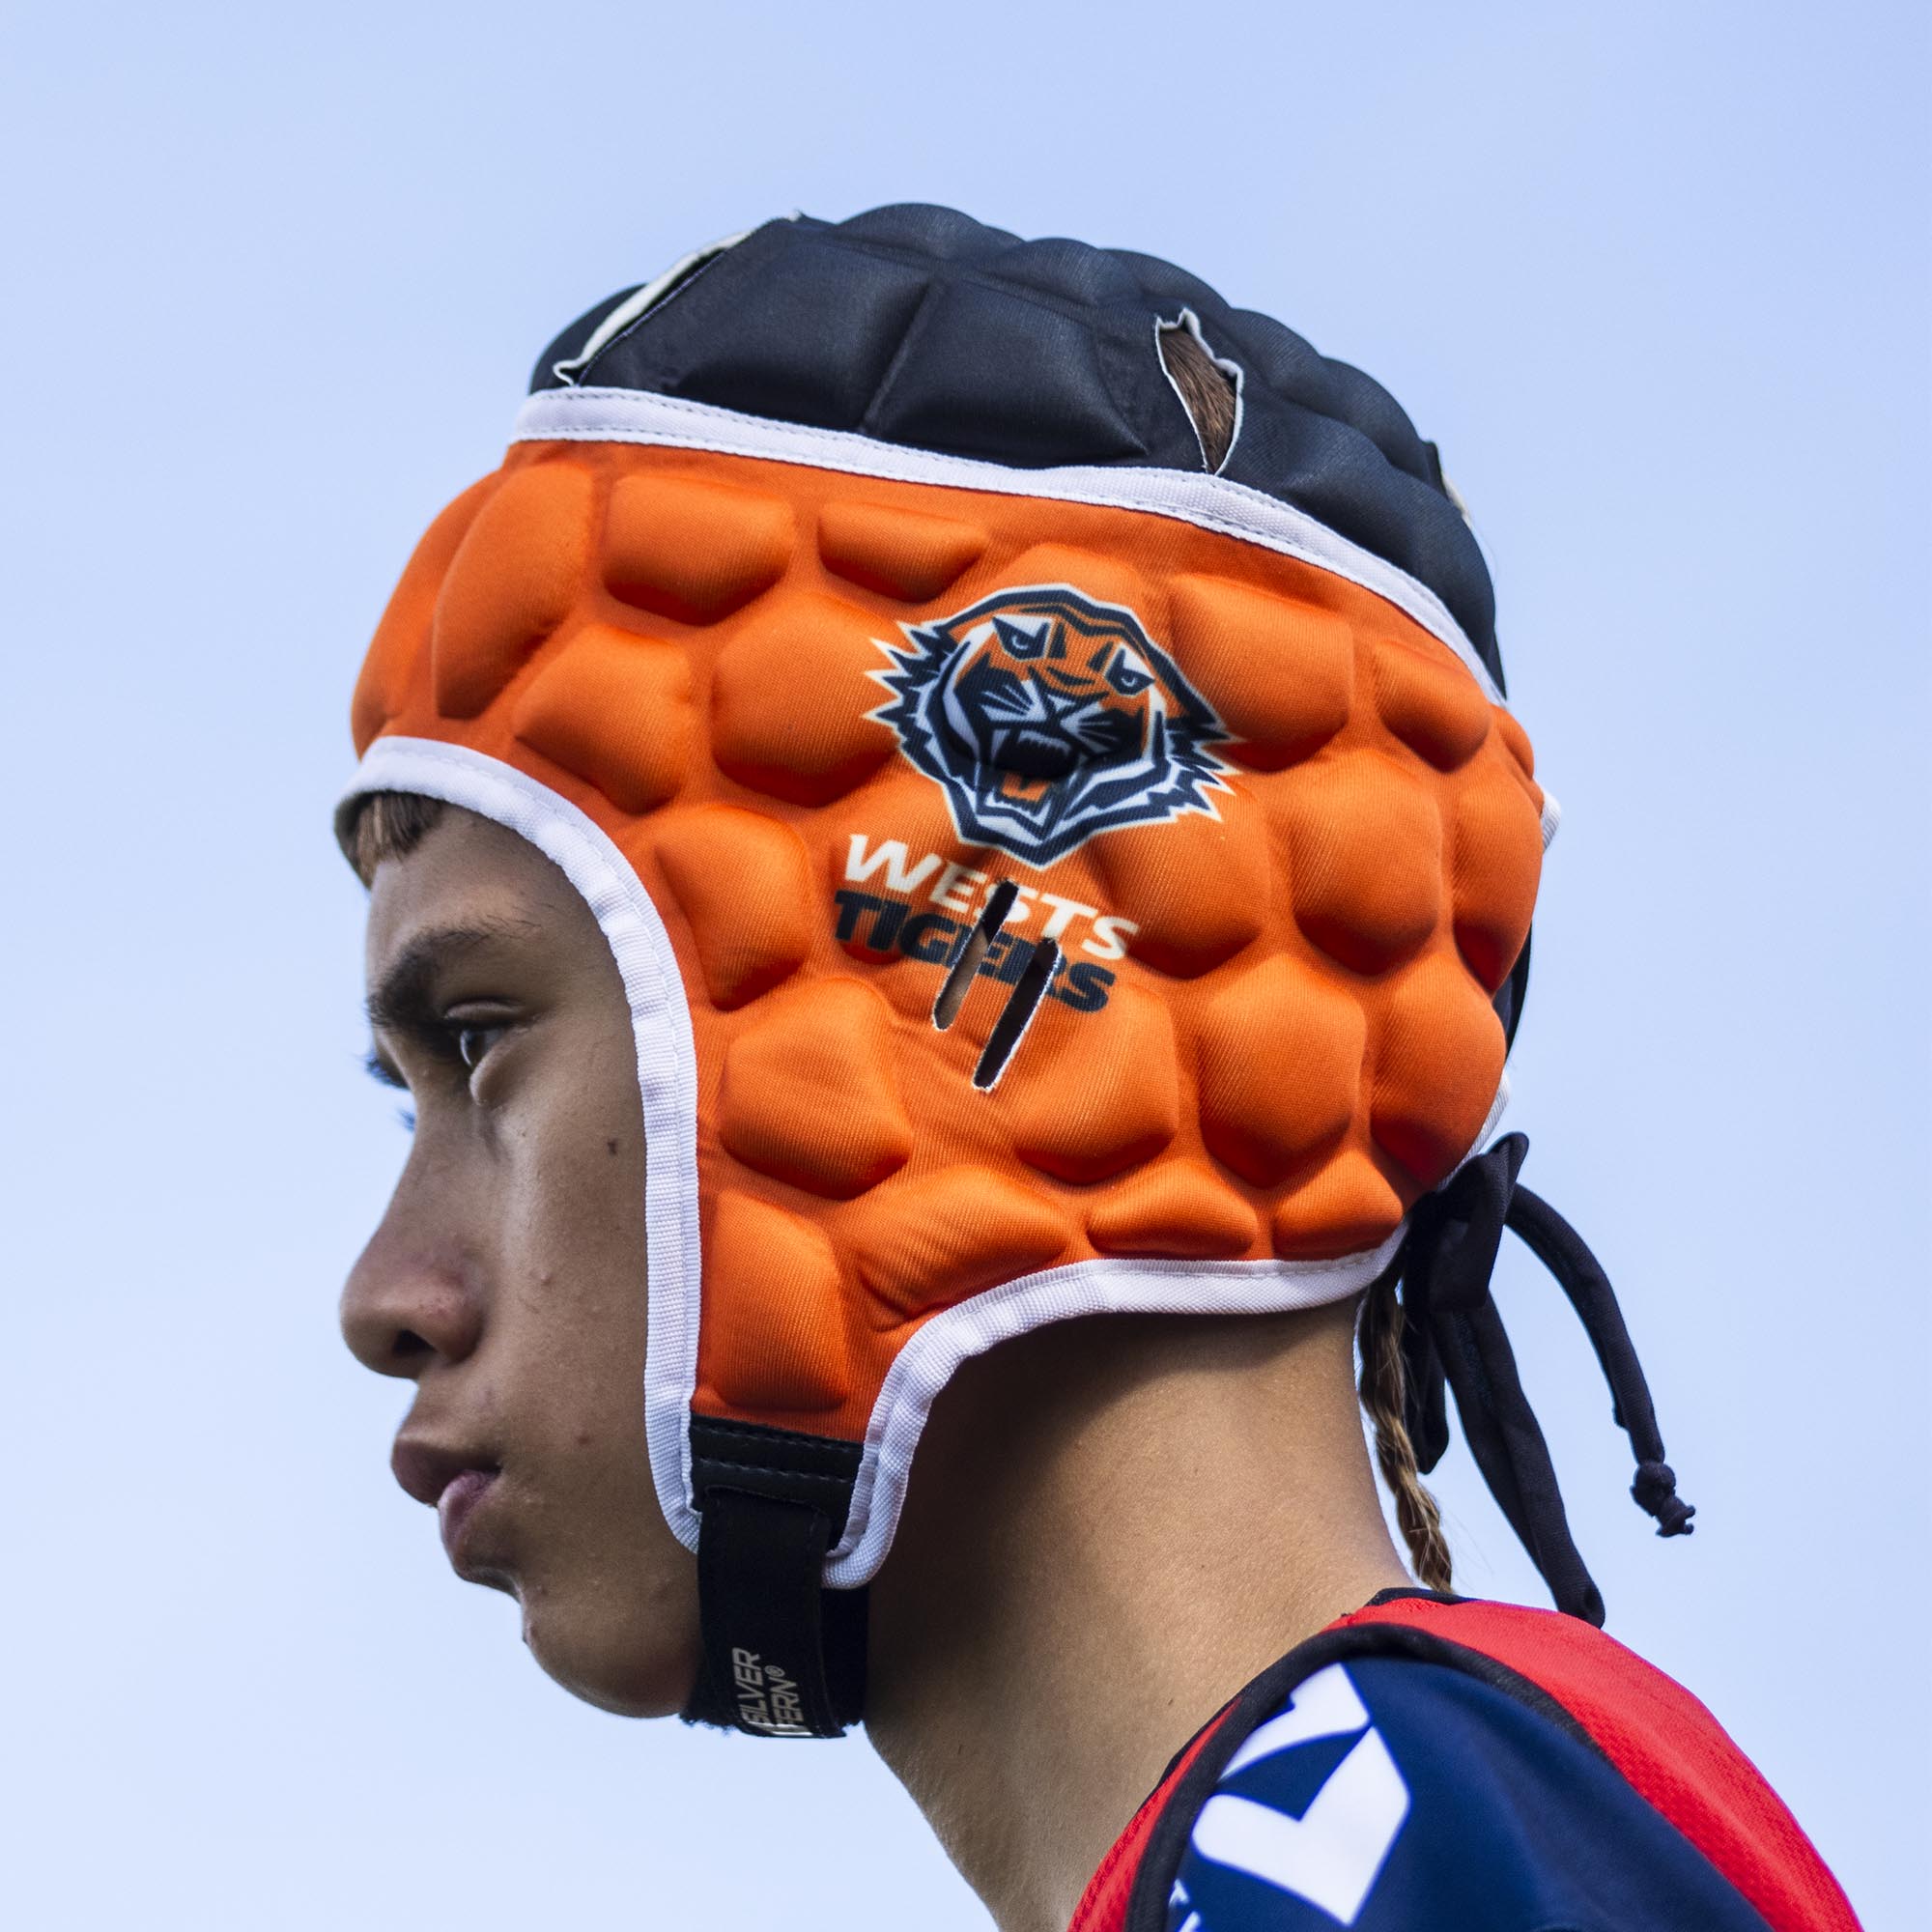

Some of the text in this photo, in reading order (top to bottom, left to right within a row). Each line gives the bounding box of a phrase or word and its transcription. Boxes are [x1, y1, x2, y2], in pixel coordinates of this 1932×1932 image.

[834, 889, 1116, 1013] TIGERS
[845, 834, 1140, 960] WESTS
[732, 1647, 769, 1724] SILVER
